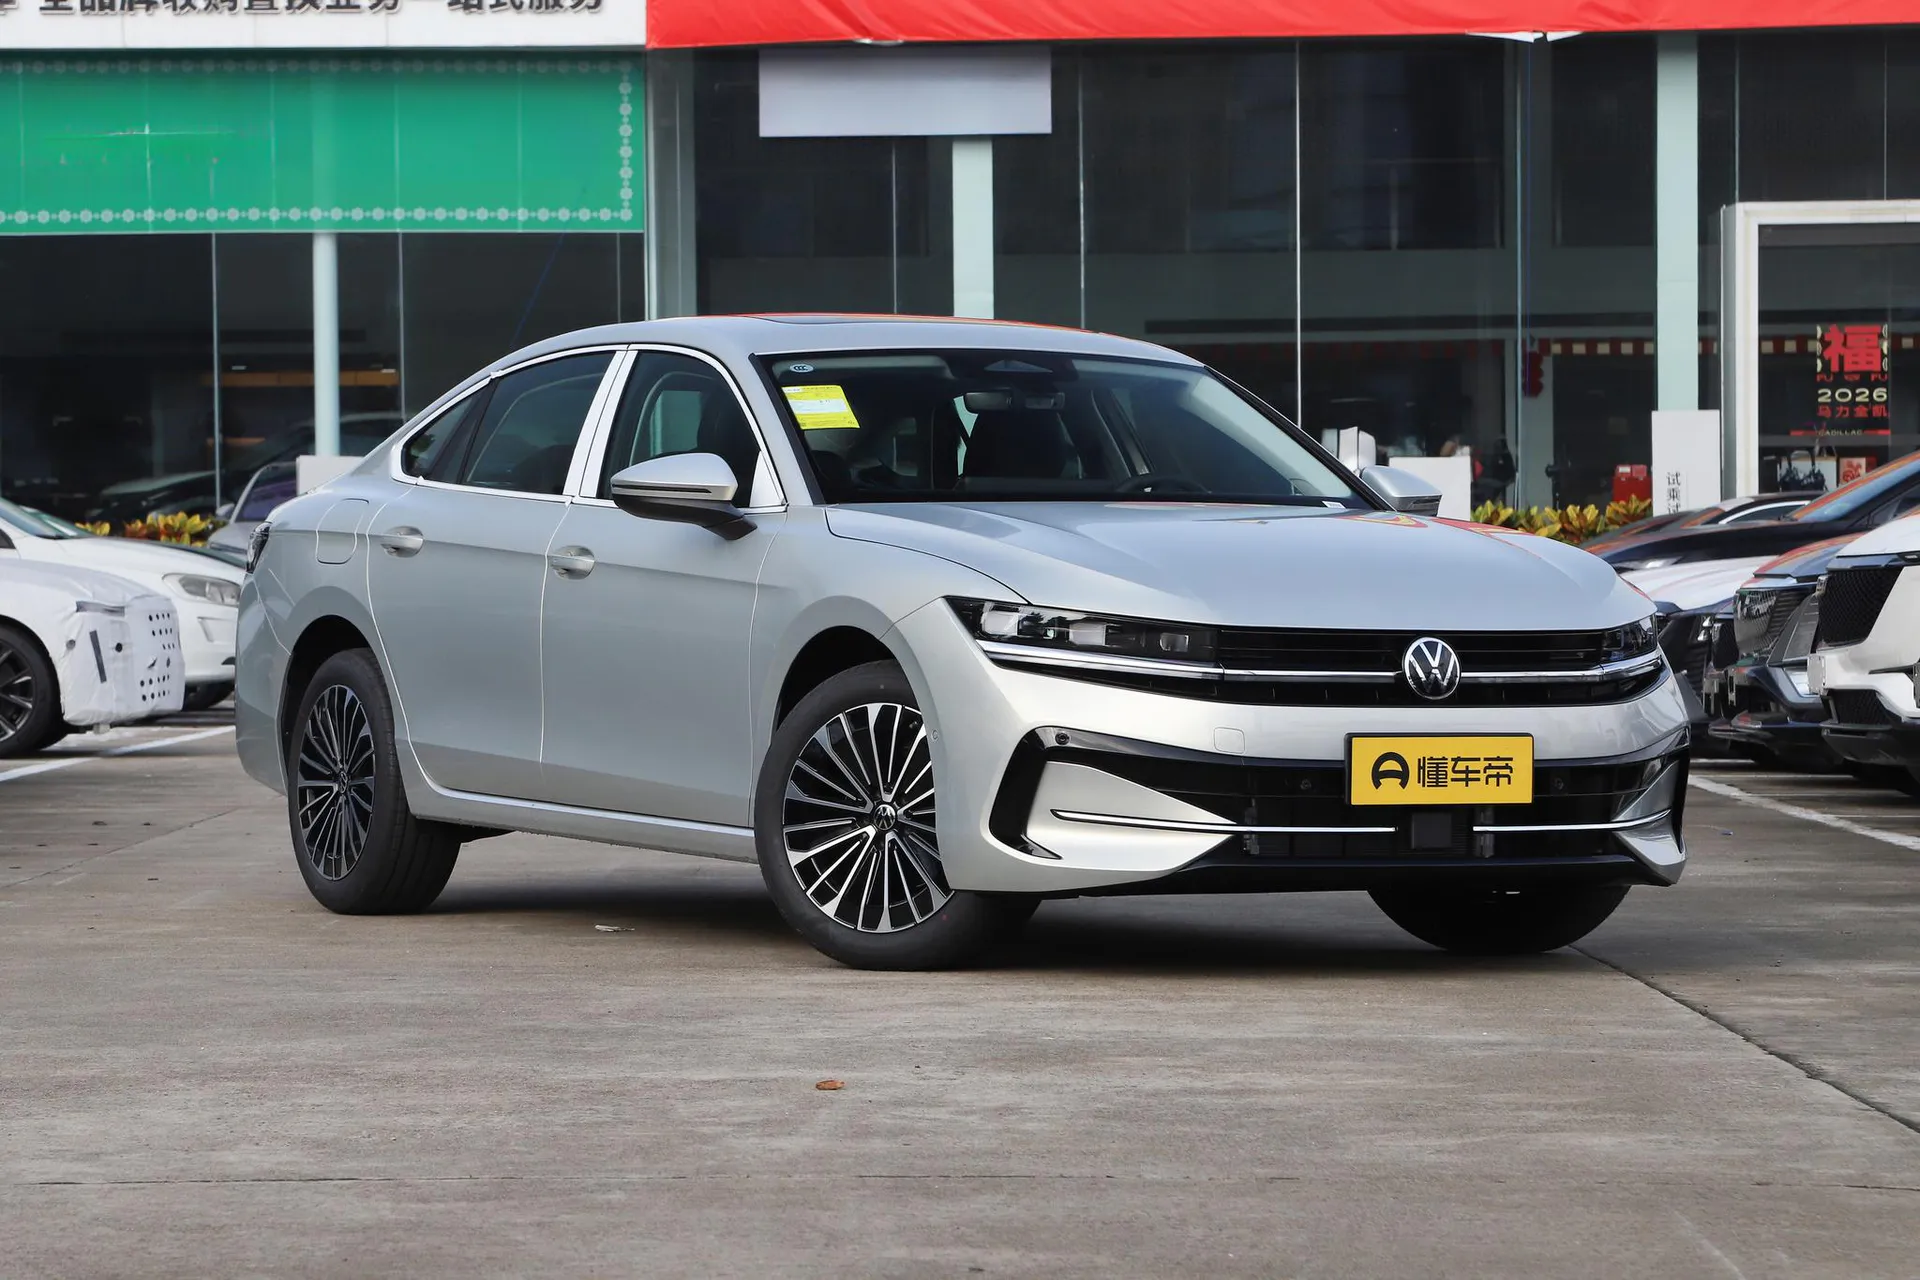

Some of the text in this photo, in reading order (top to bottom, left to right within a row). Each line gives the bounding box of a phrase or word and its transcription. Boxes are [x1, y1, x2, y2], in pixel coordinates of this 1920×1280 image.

[1823, 324, 1881, 372] 福
[1817, 387, 1888, 402] 2026
[1817, 429, 1863, 437] CADILLAC
[1417, 756, 1514, 788] 懂车帝
